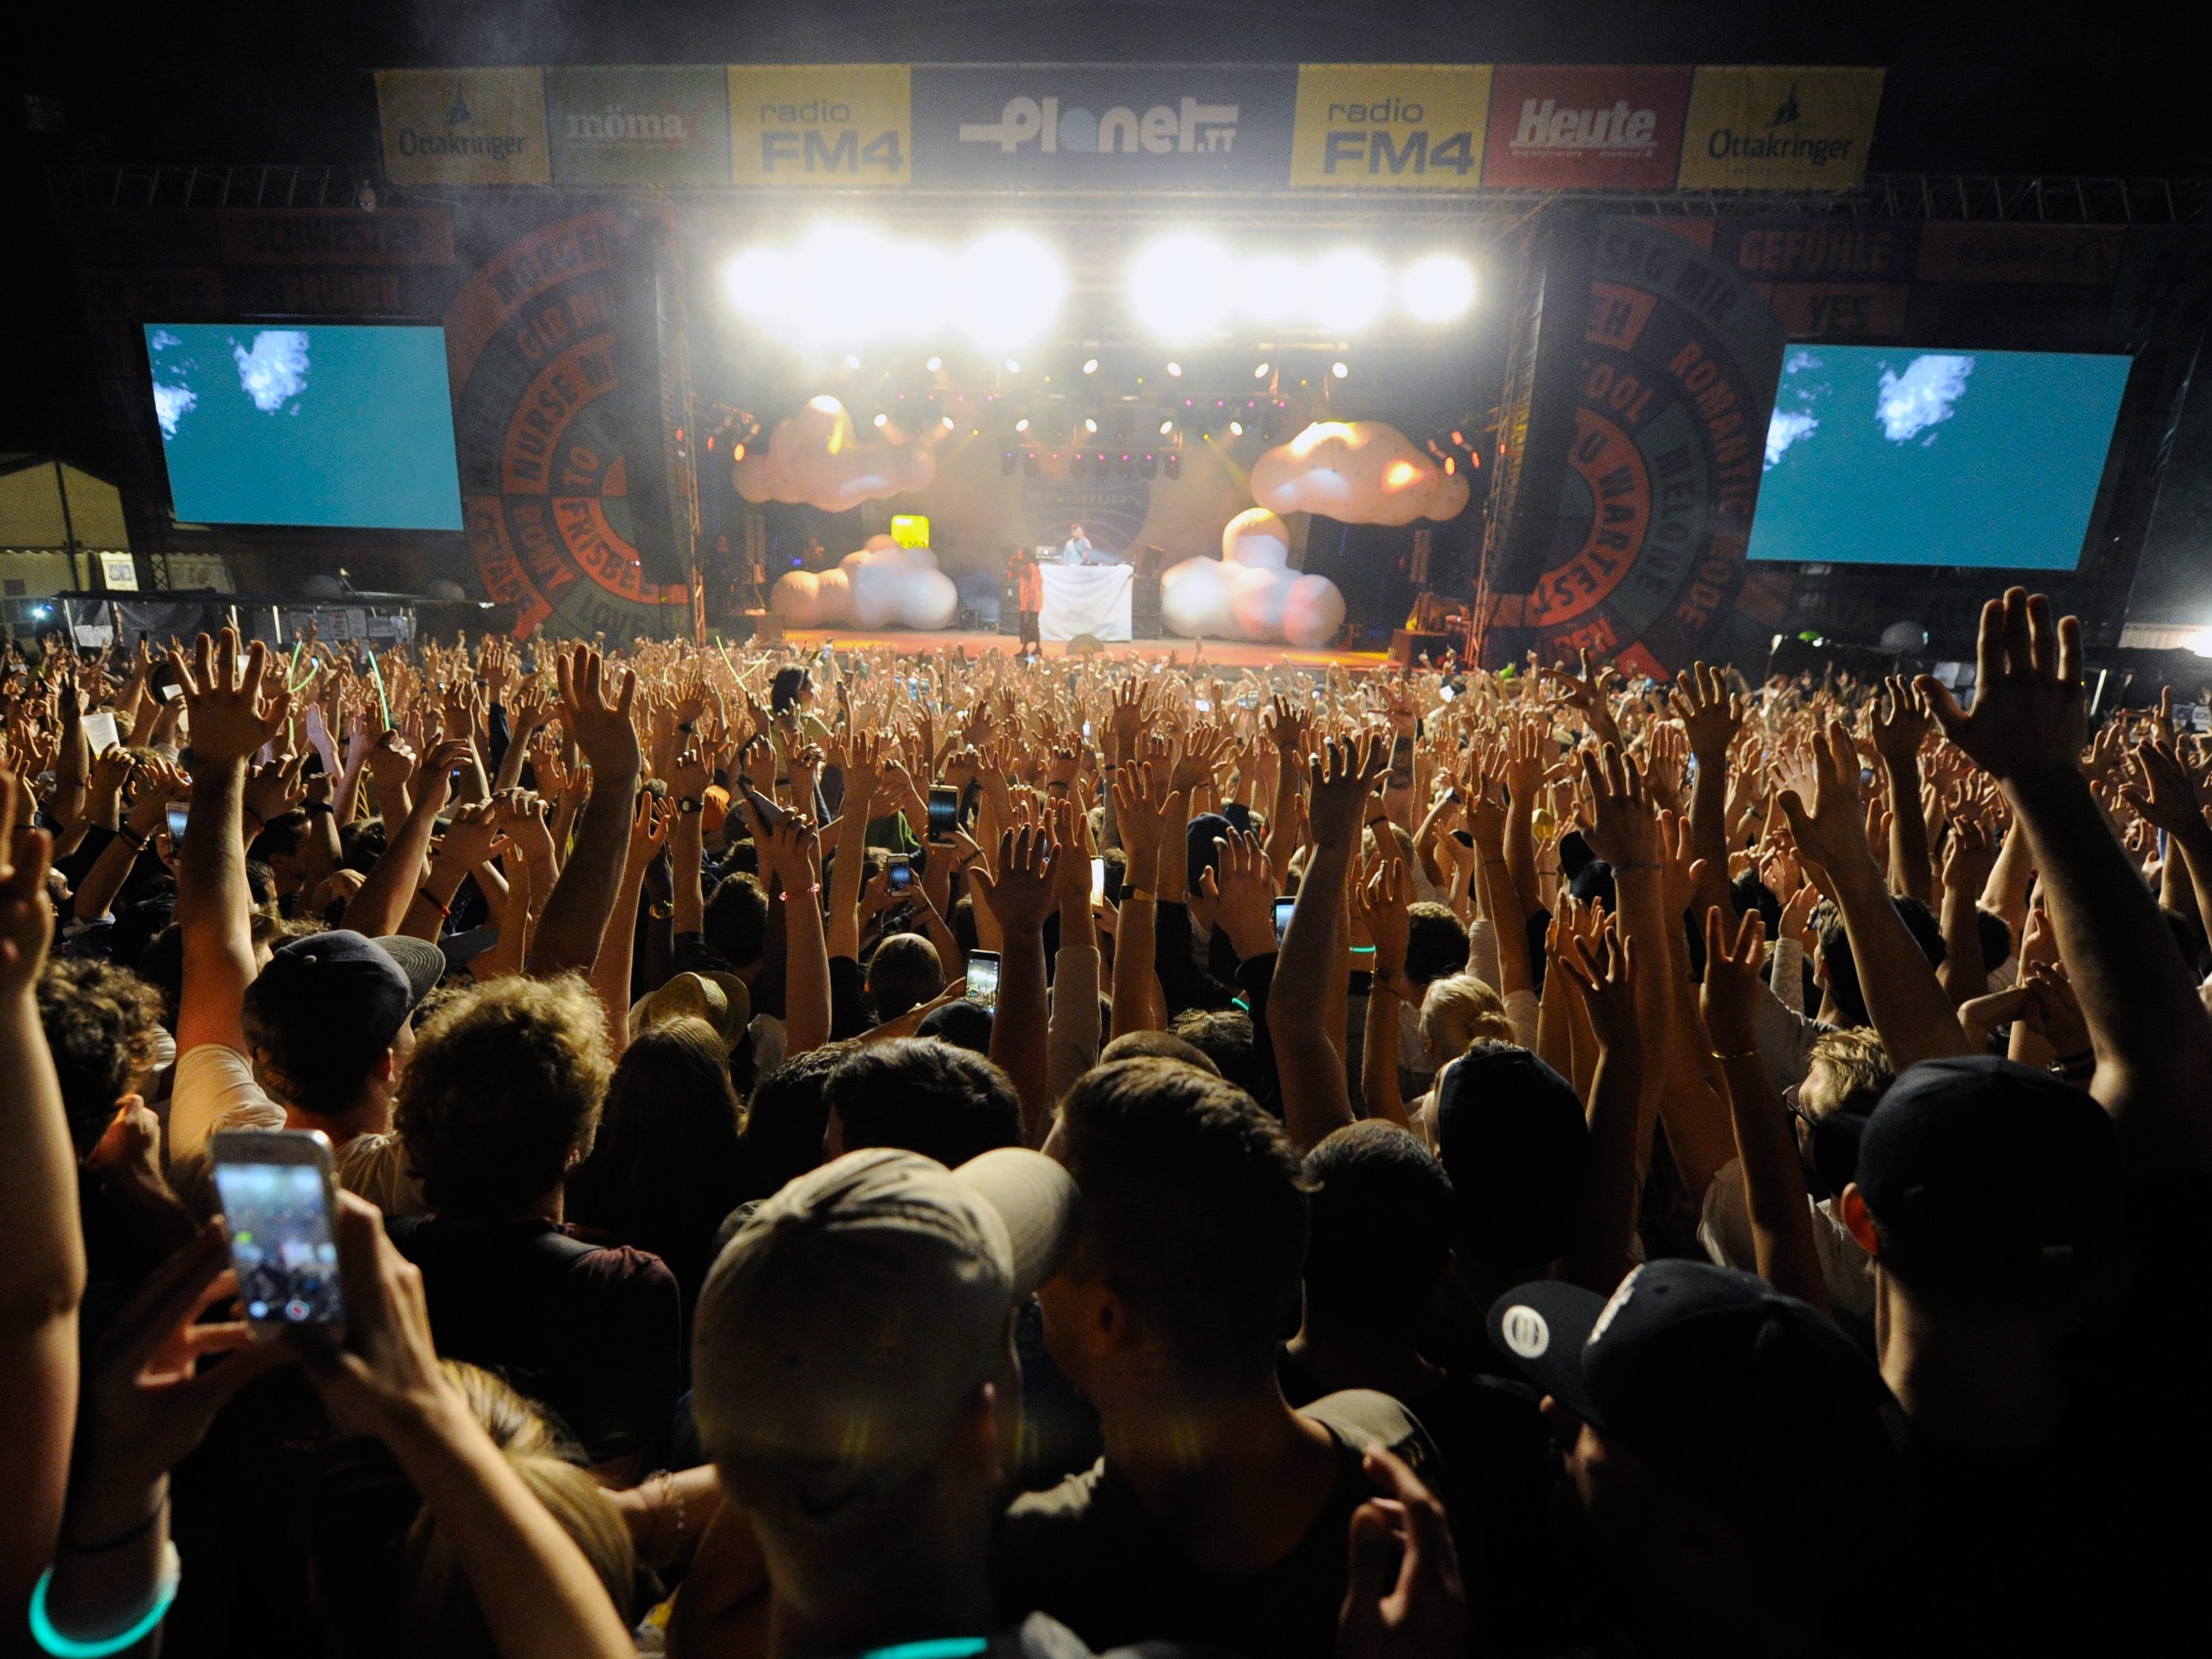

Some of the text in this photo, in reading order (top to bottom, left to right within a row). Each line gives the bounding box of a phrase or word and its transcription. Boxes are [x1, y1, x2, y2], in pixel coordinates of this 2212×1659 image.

[760, 98, 851, 123] radio
[1327, 97, 1423, 124] radio
[1516, 98, 1657, 146] Heute
[399, 129, 526, 160] Ottakringer
[761, 130, 904, 174] FM4
[1323, 130, 1474, 175] FM4
[1708, 128, 1854, 165] Ottakringer
[1604, 231, 1670, 281] SAG
[1738, 224, 1893, 272] GEFÜHLE
[516, 306, 569, 360] GIB
[1810, 294, 1870, 333] YES
